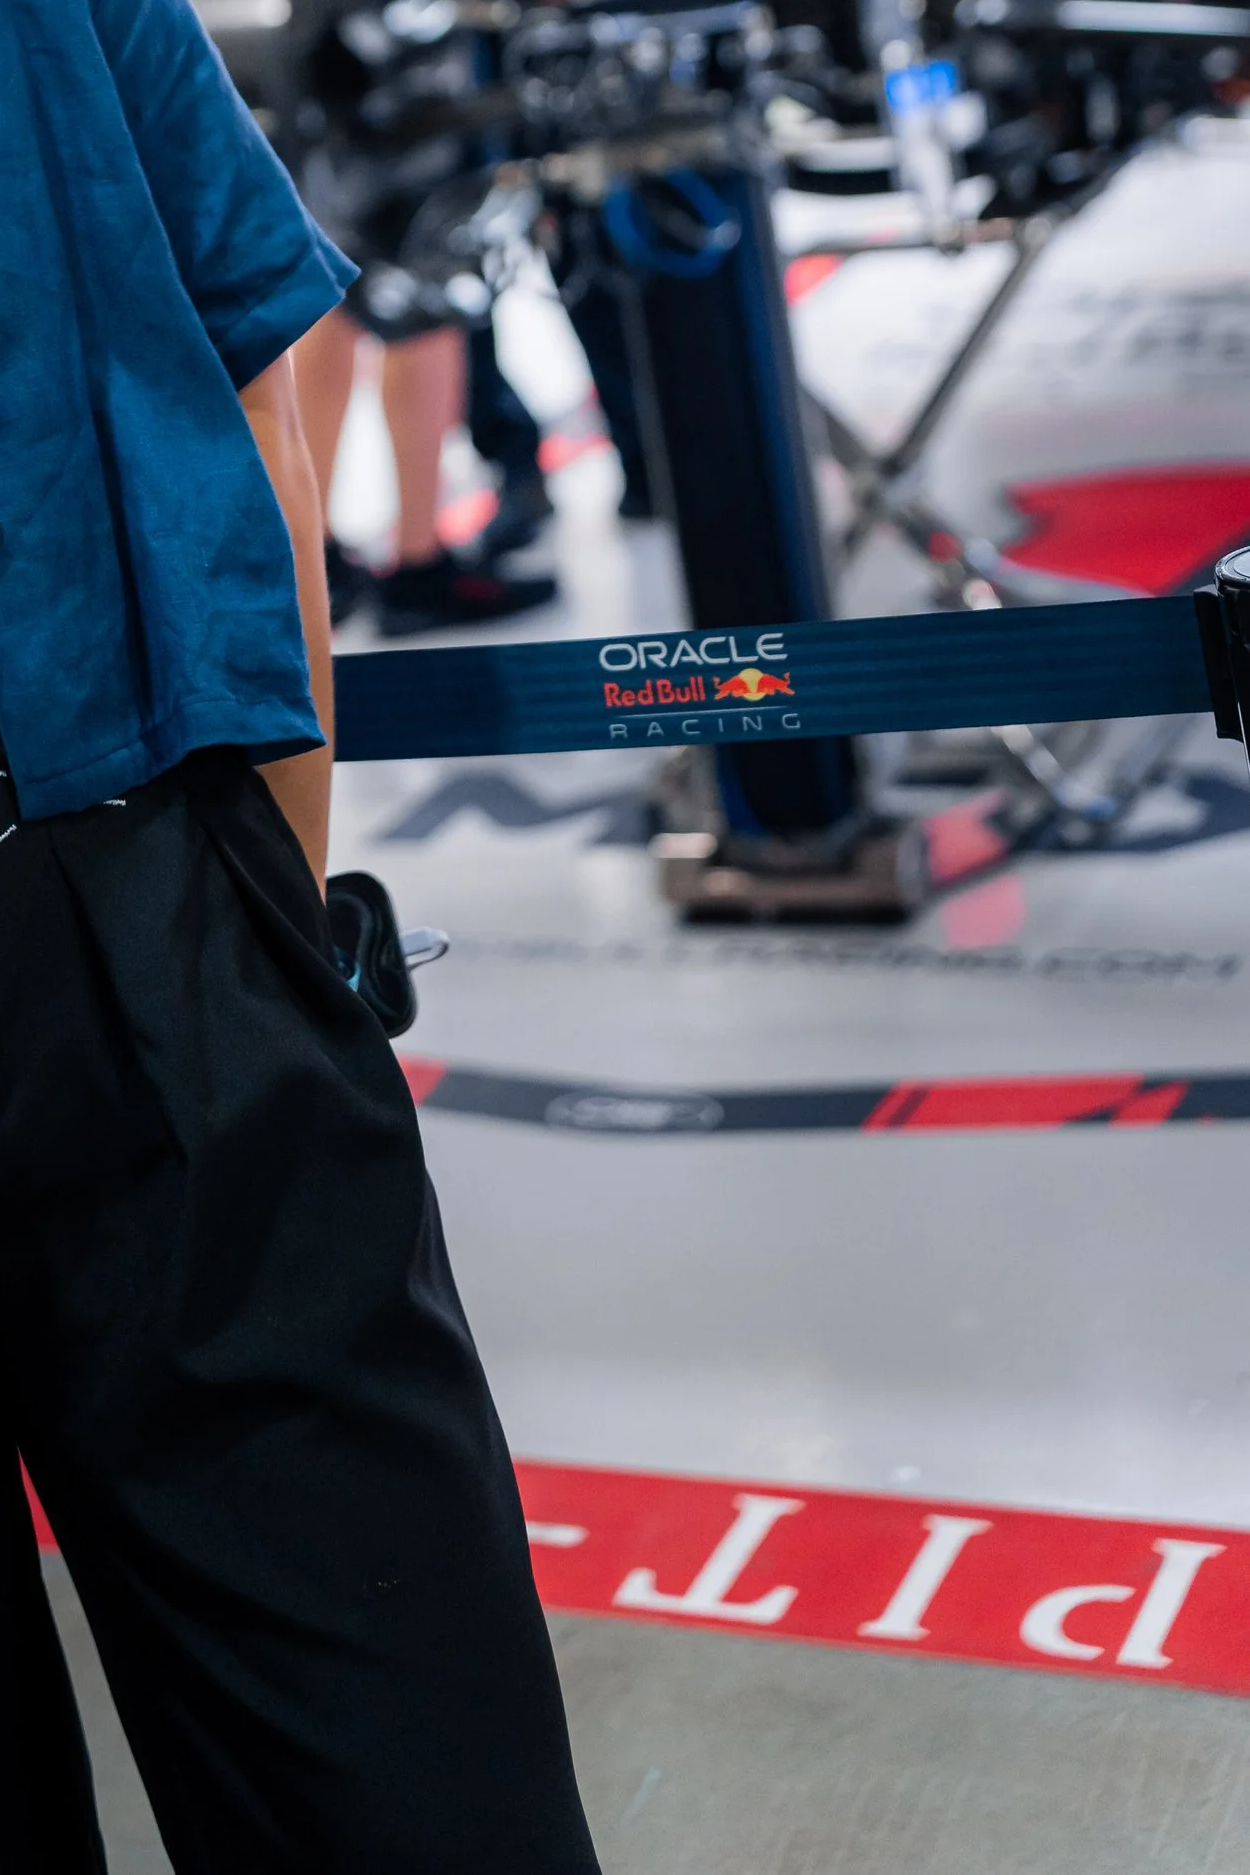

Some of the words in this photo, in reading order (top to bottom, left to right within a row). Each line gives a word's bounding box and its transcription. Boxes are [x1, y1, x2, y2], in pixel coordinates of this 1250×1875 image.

[599, 633, 788, 672] ORACLE
[603, 680, 655, 708] Red
[657, 675, 706, 705] Bull
[608, 712, 802, 740] RACING
